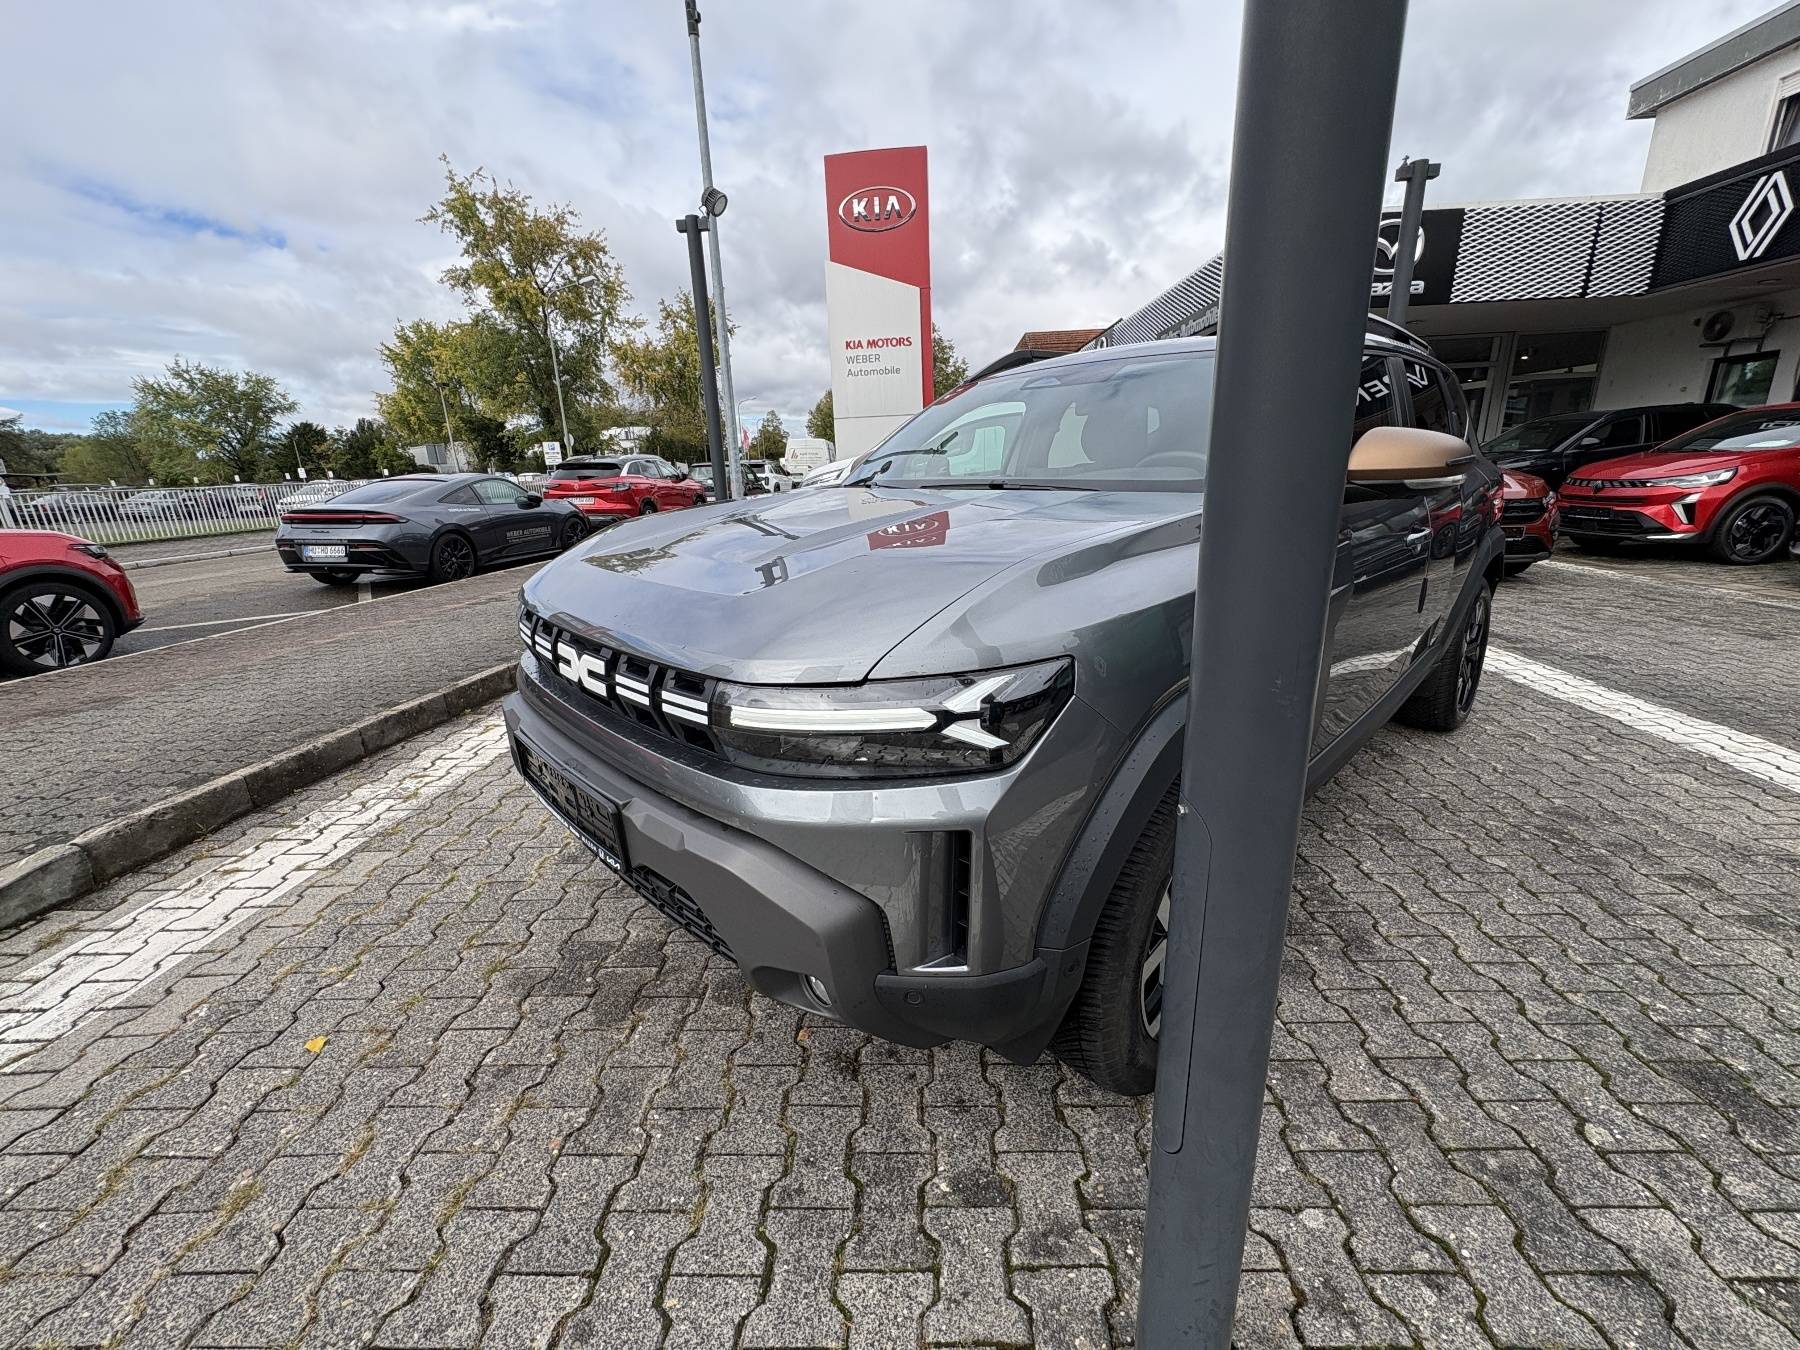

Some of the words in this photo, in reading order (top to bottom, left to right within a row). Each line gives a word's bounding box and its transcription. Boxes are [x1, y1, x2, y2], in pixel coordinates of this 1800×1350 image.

[852, 194, 903, 222] KIA
[845, 339, 864, 350] KIA
[866, 336, 913, 349] MOTORS
[846, 353, 881, 365] WEBER
[846, 366, 901, 378] Automobile
